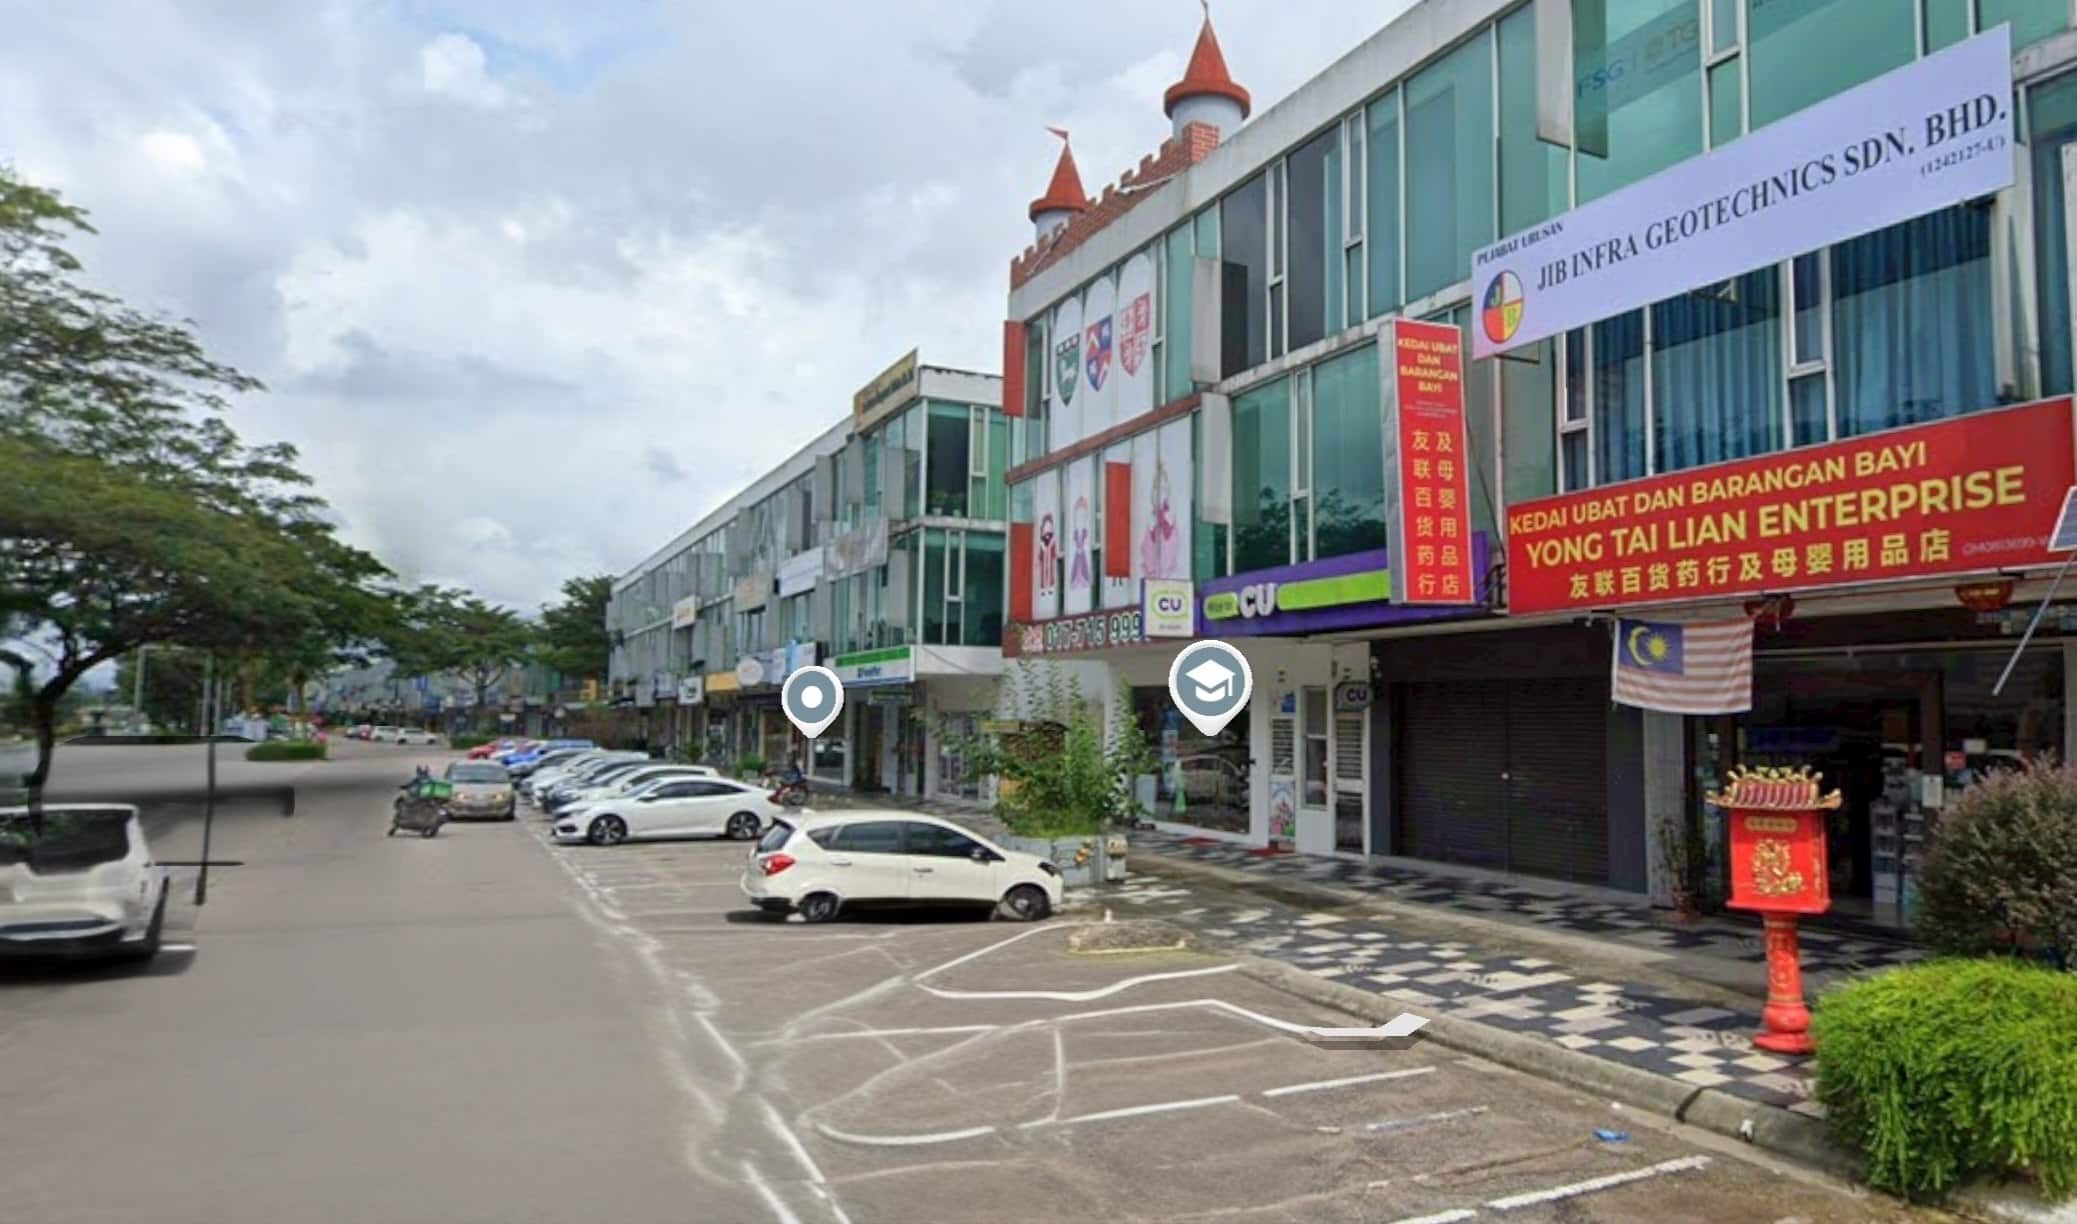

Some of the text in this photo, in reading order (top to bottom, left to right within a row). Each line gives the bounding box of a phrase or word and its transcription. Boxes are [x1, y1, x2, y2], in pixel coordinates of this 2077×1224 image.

[1537, 93, 2007, 291] JIB INFRA GEOTECHNICS SDN. BHD.
[1398, 337, 1458, 354] KEDAI UBAT
[1417, 352, 1441, 366] DAN
[1400, 365, 1458, 382] BARANGAN
[1418, 381, 1443, 393] BAYI
[1509, 440, 1927, 535] KEDAI UBAT DAN BARANGAN BAYI
[1526, 464, 2027, 569] YONG TAI LIAN ENTERPRISE
[1569, 528, 1950, 600] 友联百货药行及母婴用品店
[1158, 597, 1182, 612] CU
[1241, 582, 1276, 619] CU
[1347, 688, 1367, 702] CU
